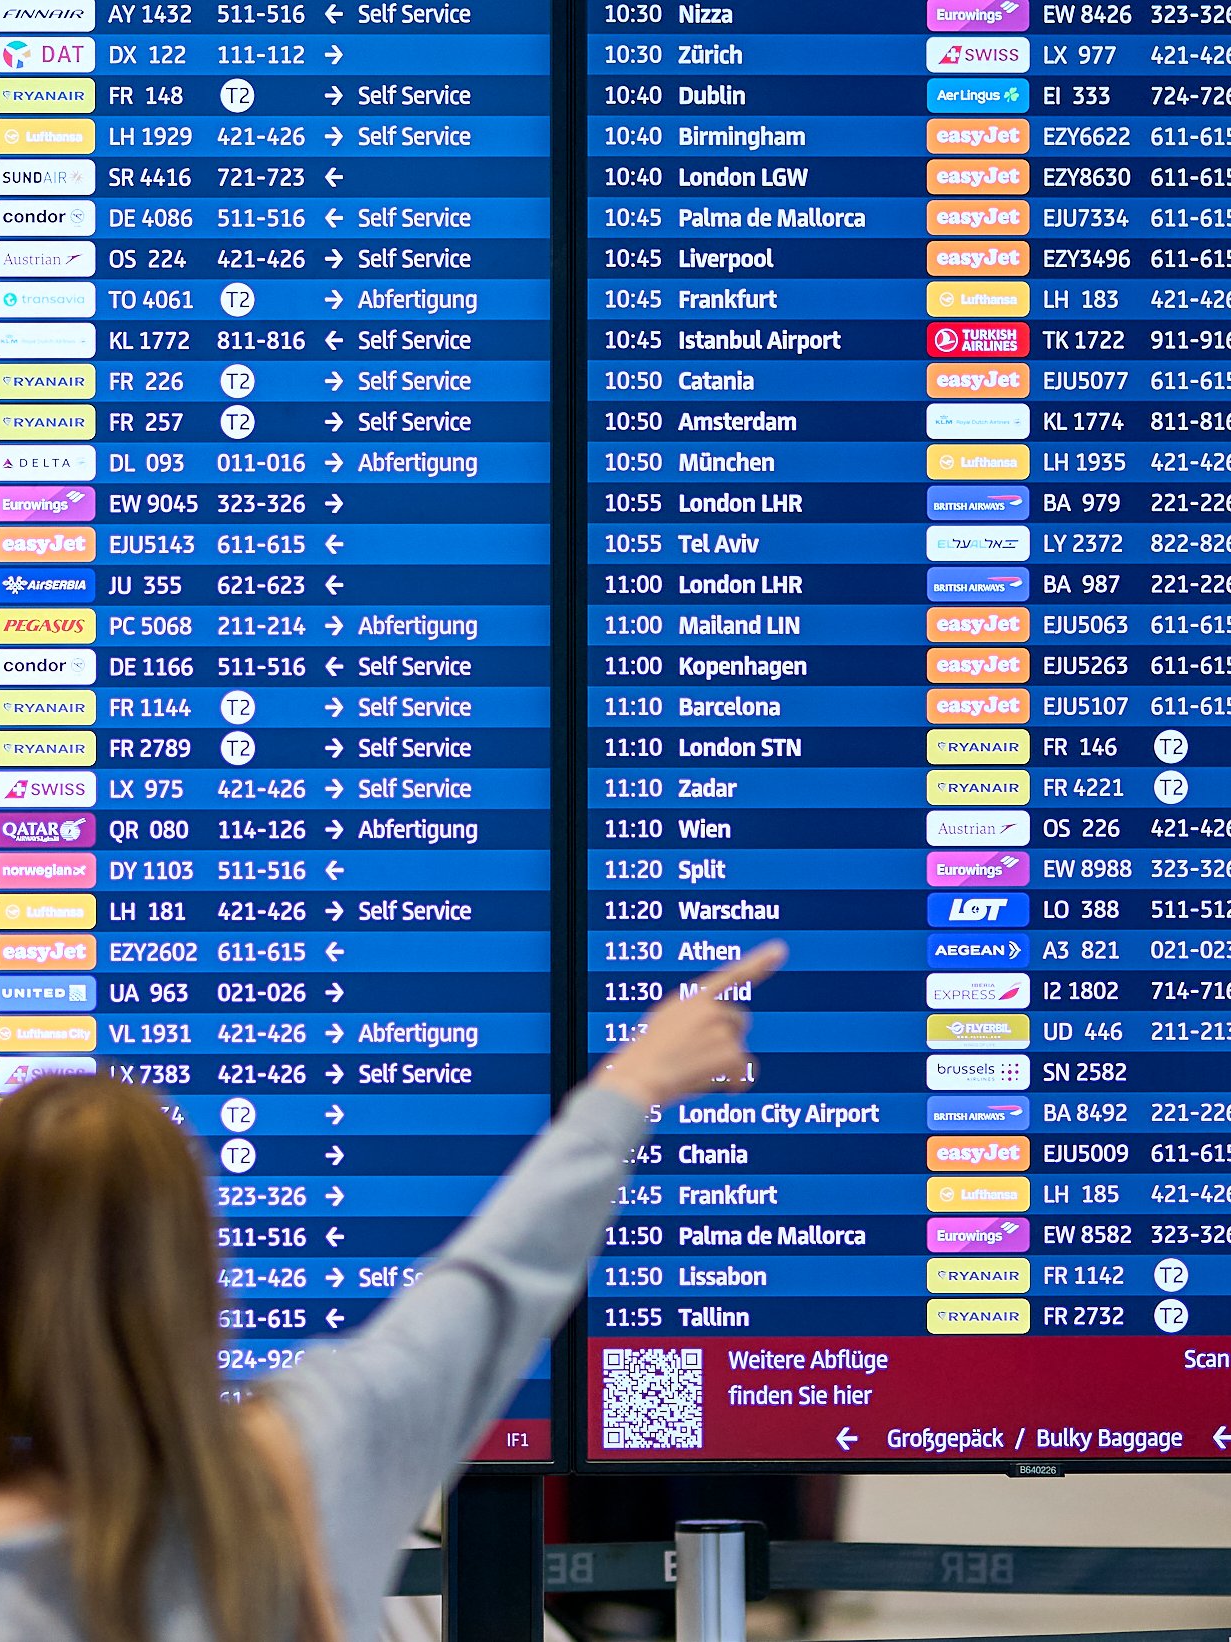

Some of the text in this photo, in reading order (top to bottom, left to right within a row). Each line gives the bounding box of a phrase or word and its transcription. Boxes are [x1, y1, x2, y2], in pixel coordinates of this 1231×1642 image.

[2, 9, 84, 19] FINNAIR
[107, 4, 136, 24] AY
[141, 4, 192, 24] 1432
[217, 4, 306, 24] 511-516
[358, 2, 398, 24] Self
[401, 2, 471, 24] Service
[605, 84, 1111, 105] 10:40 Dublin Aer Lingus EI 333
[605, 329, 1125, 355] 10:45 Istanbul Airport TK 1722
[961, 329, 1017, 340] TURKISH
[961, 340, 1018, 351] AIRLINES
[19, 458, 71, 468] DELTA
[109, 453, 136, 473] DL
[146, 453, 185, 473] 093
[217, 453, 306, 473] 011-016
[357, 451, 478, 478] Abfertigung
[3, 619, 85, 633] PEGASUS
[110, 616, 136, 636] PC
[141, 616, 193, 636] 5068
[217, 616, 307, 636] 211-214
[357, 614, 478, 641] Abfertigung
[605, 777, 1184, 798] 11:10 Zadar RYANAIR FR 4221 T2
[2, 821, 60, 839] QATAR
[109, 820, 139, 844] QR
[149, 820, 189, 840] 080
[218, 819, 306, 840] 114-126
[357, 818, 478, 845] Abfertigung
[605, 940, 1120, 962] 11:30 Athen AEGEAN A3 821
[1, 987, 66, 998] UNITED
[110, 983, 140, 1003] UA
[149, 983, 189, 1003] 963
[217, 982, 307, 1003] 021-026
[934, 990, 996, 1000] EXPRESS
[1043, 981, 1119, 1000] I2 1802
[937, 1063, 995, 1075] brussels
[1043, 1062, 1127, 1082] SN 2582
[217, 1186, 307, 1207] 323-326
[605, 1307, 1184, 1327] 11:55 Tallinn RYANAIR FR 2732 T2
[728, 1348, 888, 1374] Weitere Abflüge
[1184, 1350, 1230, 1369] Scan
[728, 1384, 872, 1406] finden Sie hier
[506, 1432, 529, 1448] IF1
[887, 1427, 1004, 1454] Großgepäck
[1036, 1427, 1092, 1452] Bulky
[1097, 1428, 1183, 1453] Baggage
[1019, 1465, 1057, 1475] B640226
